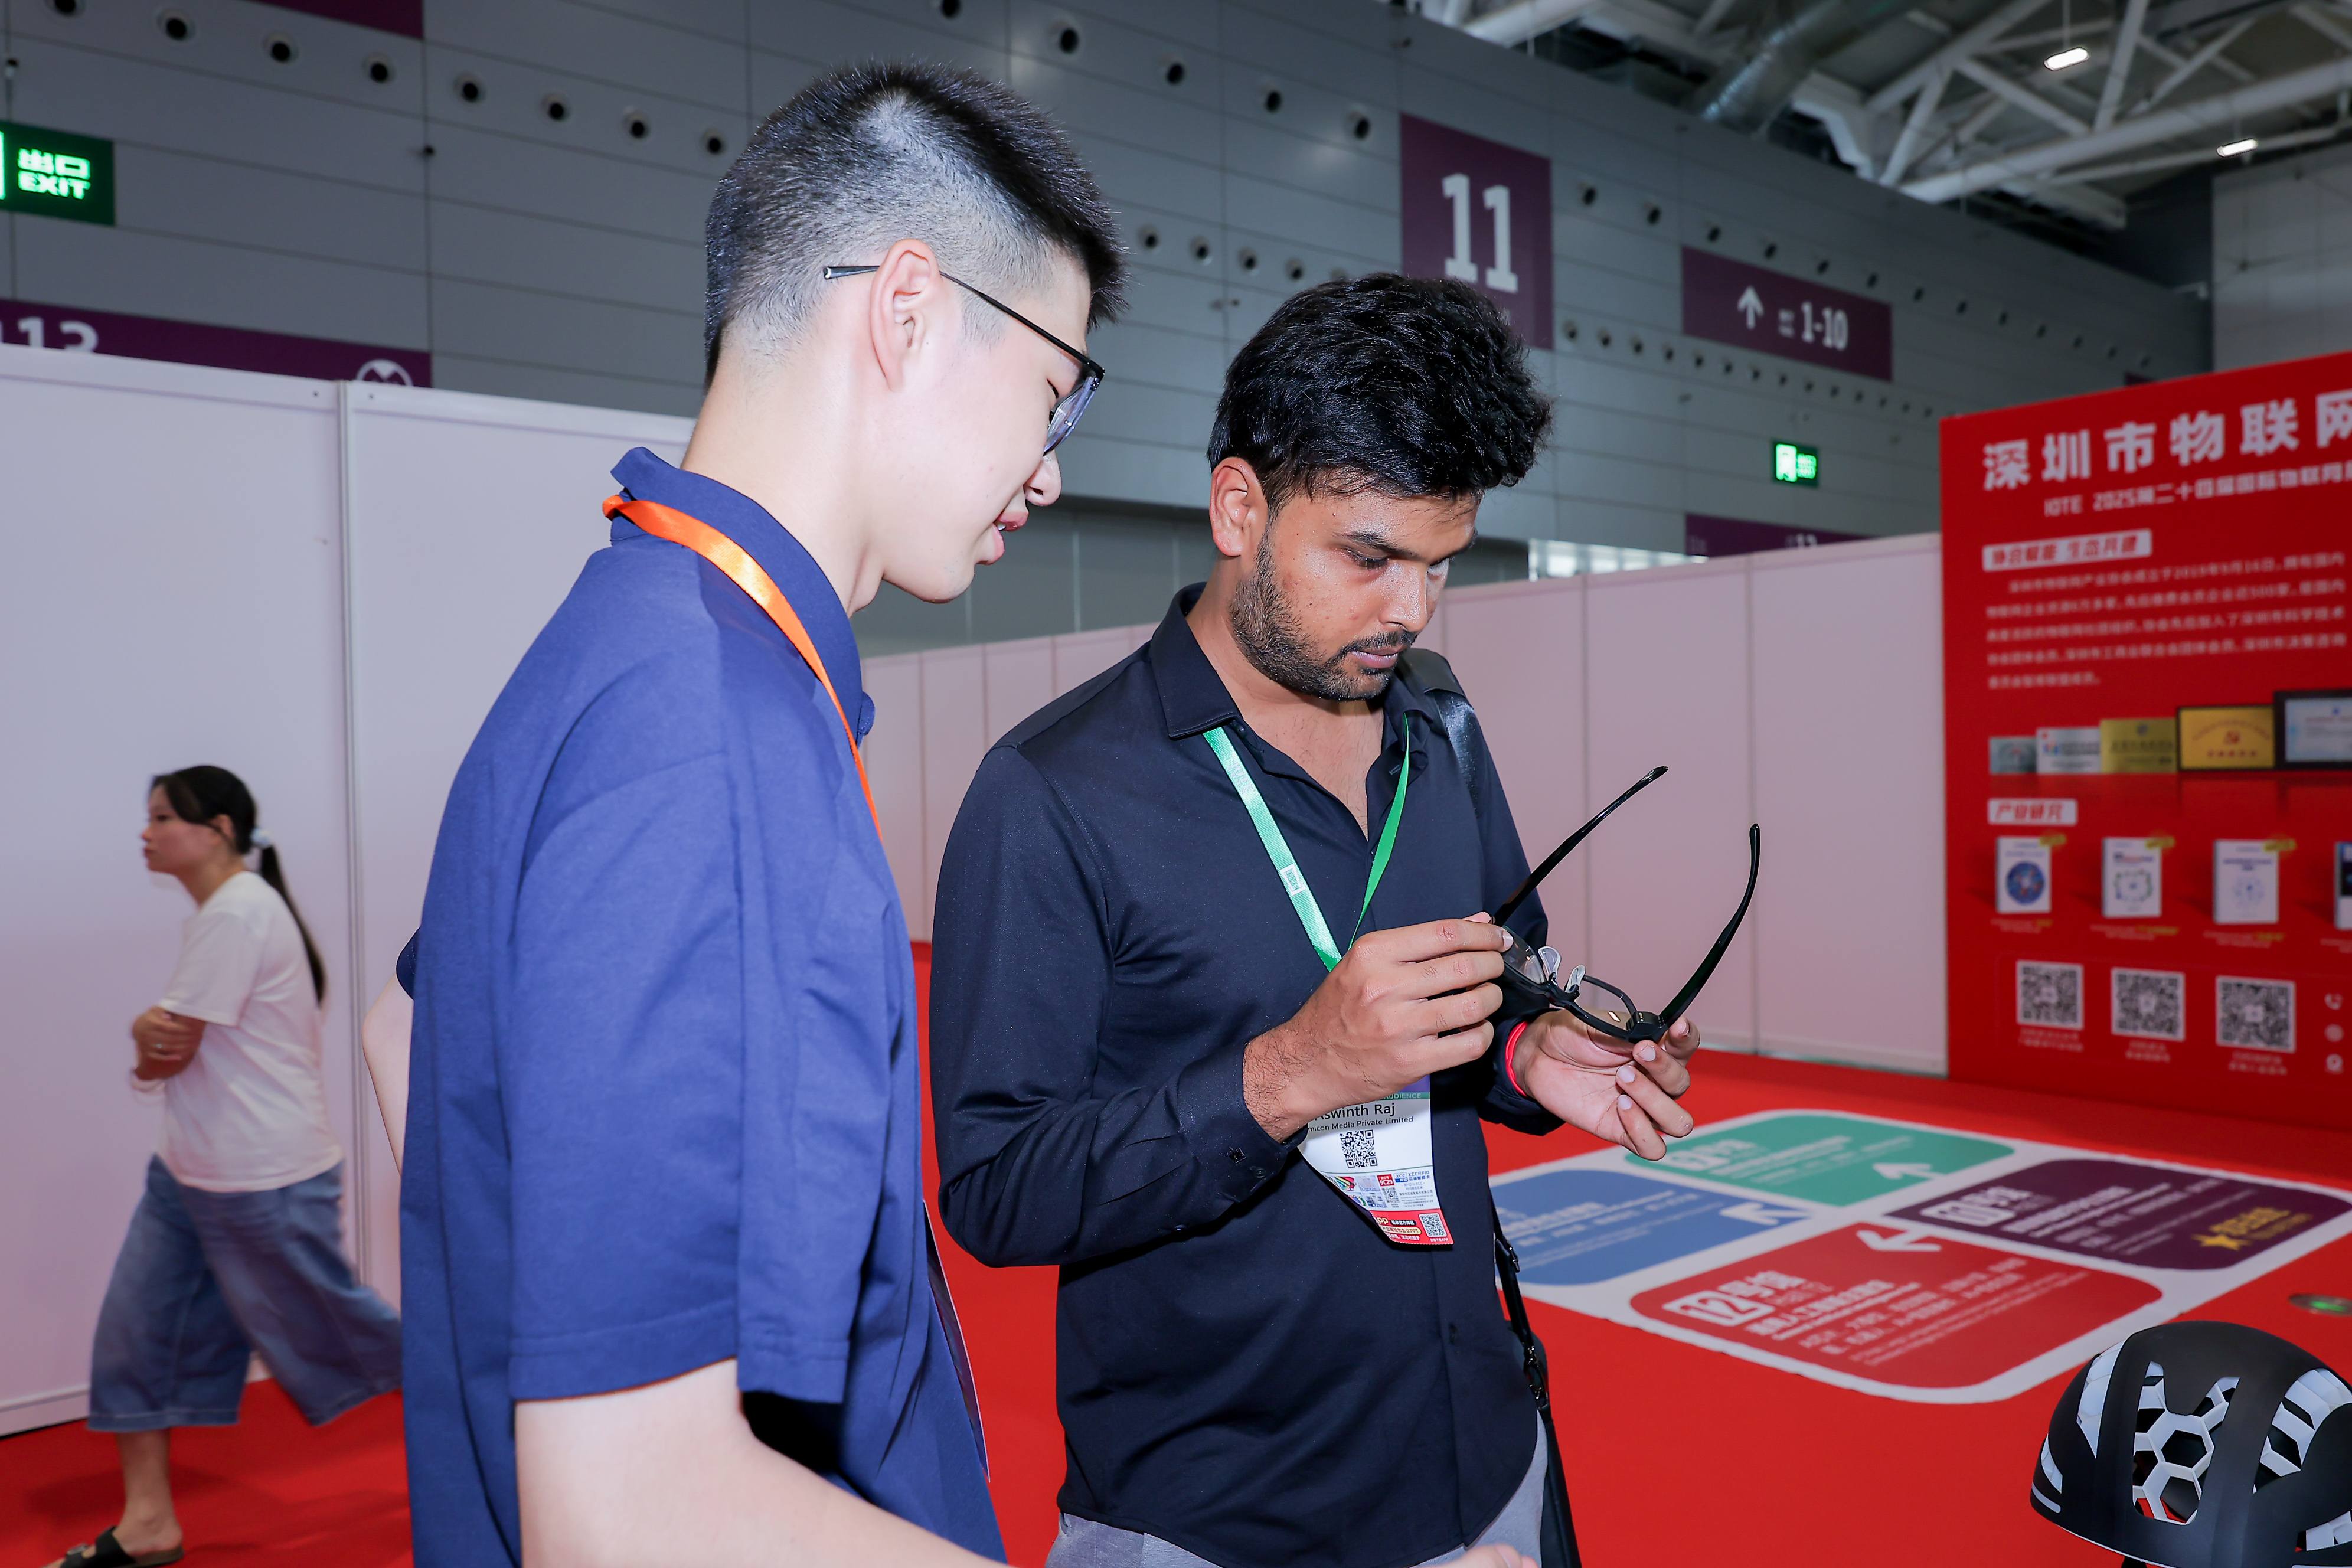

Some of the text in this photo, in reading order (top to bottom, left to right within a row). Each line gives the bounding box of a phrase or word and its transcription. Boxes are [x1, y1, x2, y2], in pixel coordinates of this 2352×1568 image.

[18, 148, 90, 180] 出口
[18, 171, 91, 200] EXIT
[1442, 172, 1518, 293] 11
[1801, 301, 1849, 351] 1-10
[2044, 494, 2083, 518] IOTE
[1332, 1121, 1355, 1130] Media
[1357, 1118, 1383, 1127] Private
[1386, 1116, 1413, 1125] Limited
[1374, 1102, 1395, 1118] Raj
